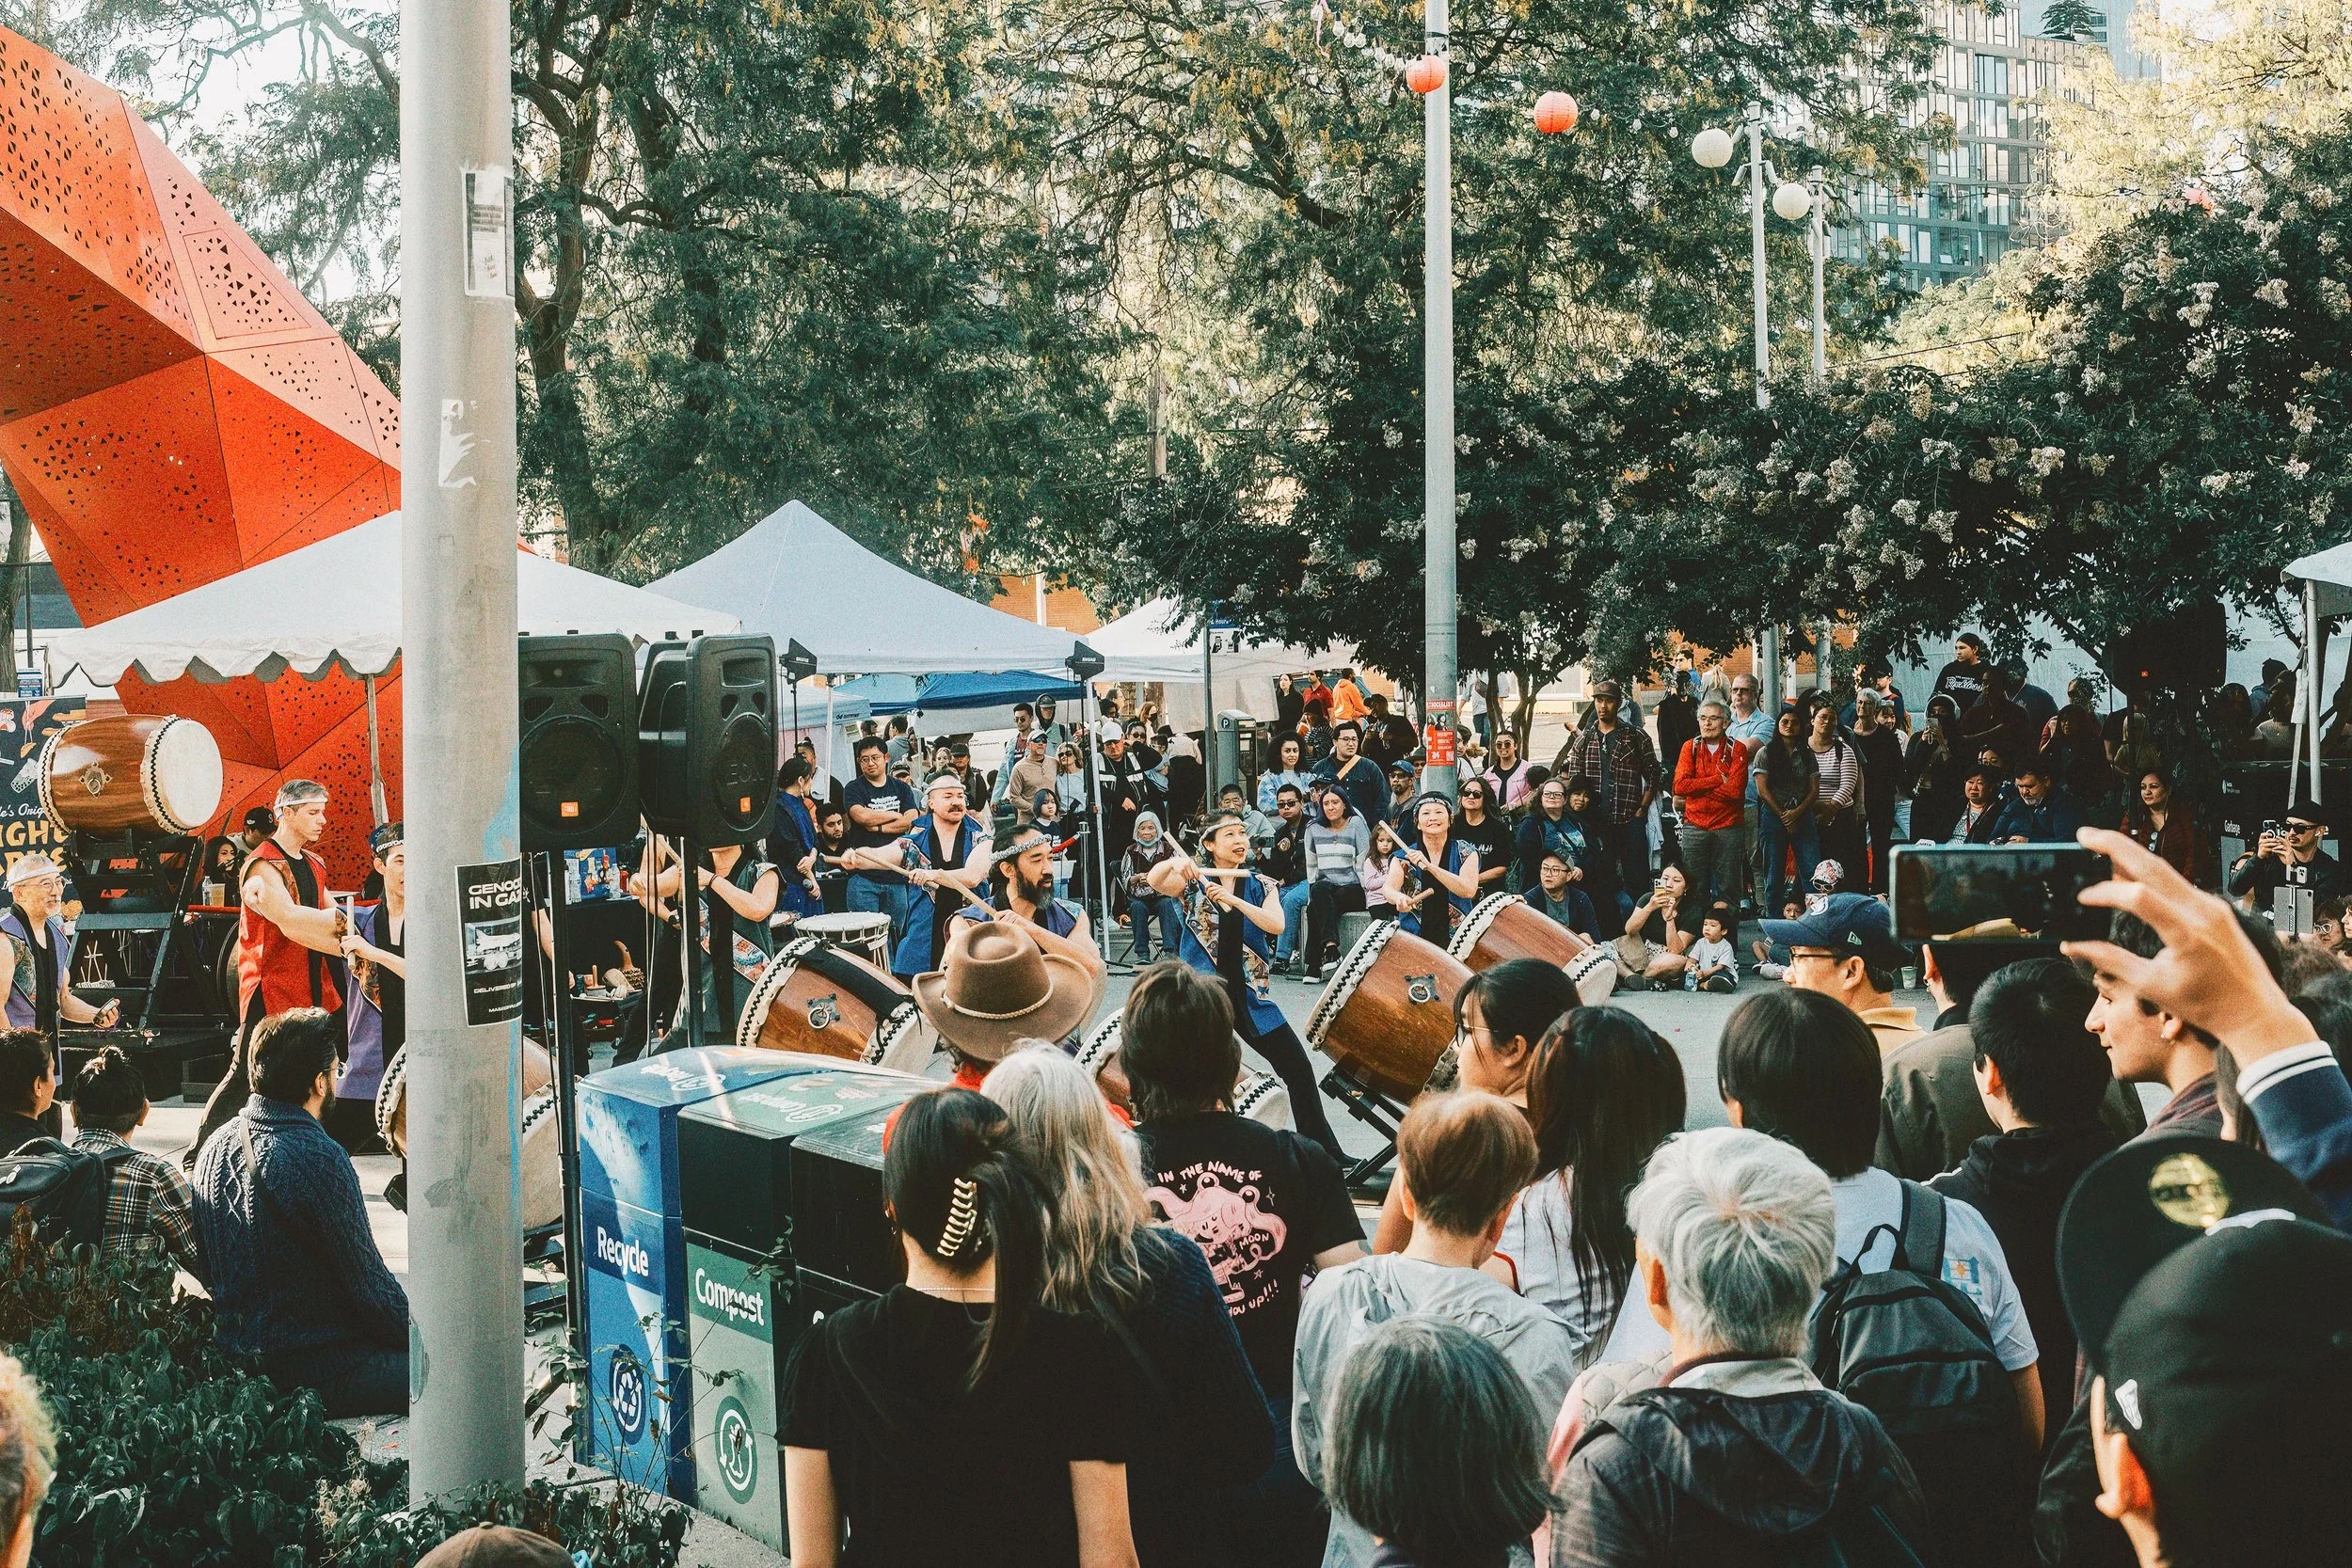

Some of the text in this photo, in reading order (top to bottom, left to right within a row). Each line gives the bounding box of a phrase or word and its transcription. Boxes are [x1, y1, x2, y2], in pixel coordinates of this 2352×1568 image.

[469, 877, 521, 895] GENOC
[469, 887, 521, 910] IN GAZ
[1157, 1160, 1263, 1183] IN THE NAME OF
[596, 1226, 649, 1277] Recycle
[1239, 1232, 1269, 1250] MOON
[695, 1267, 765, 1326] Compost
[1248, 1278, 1279, 1308] UP!!!
